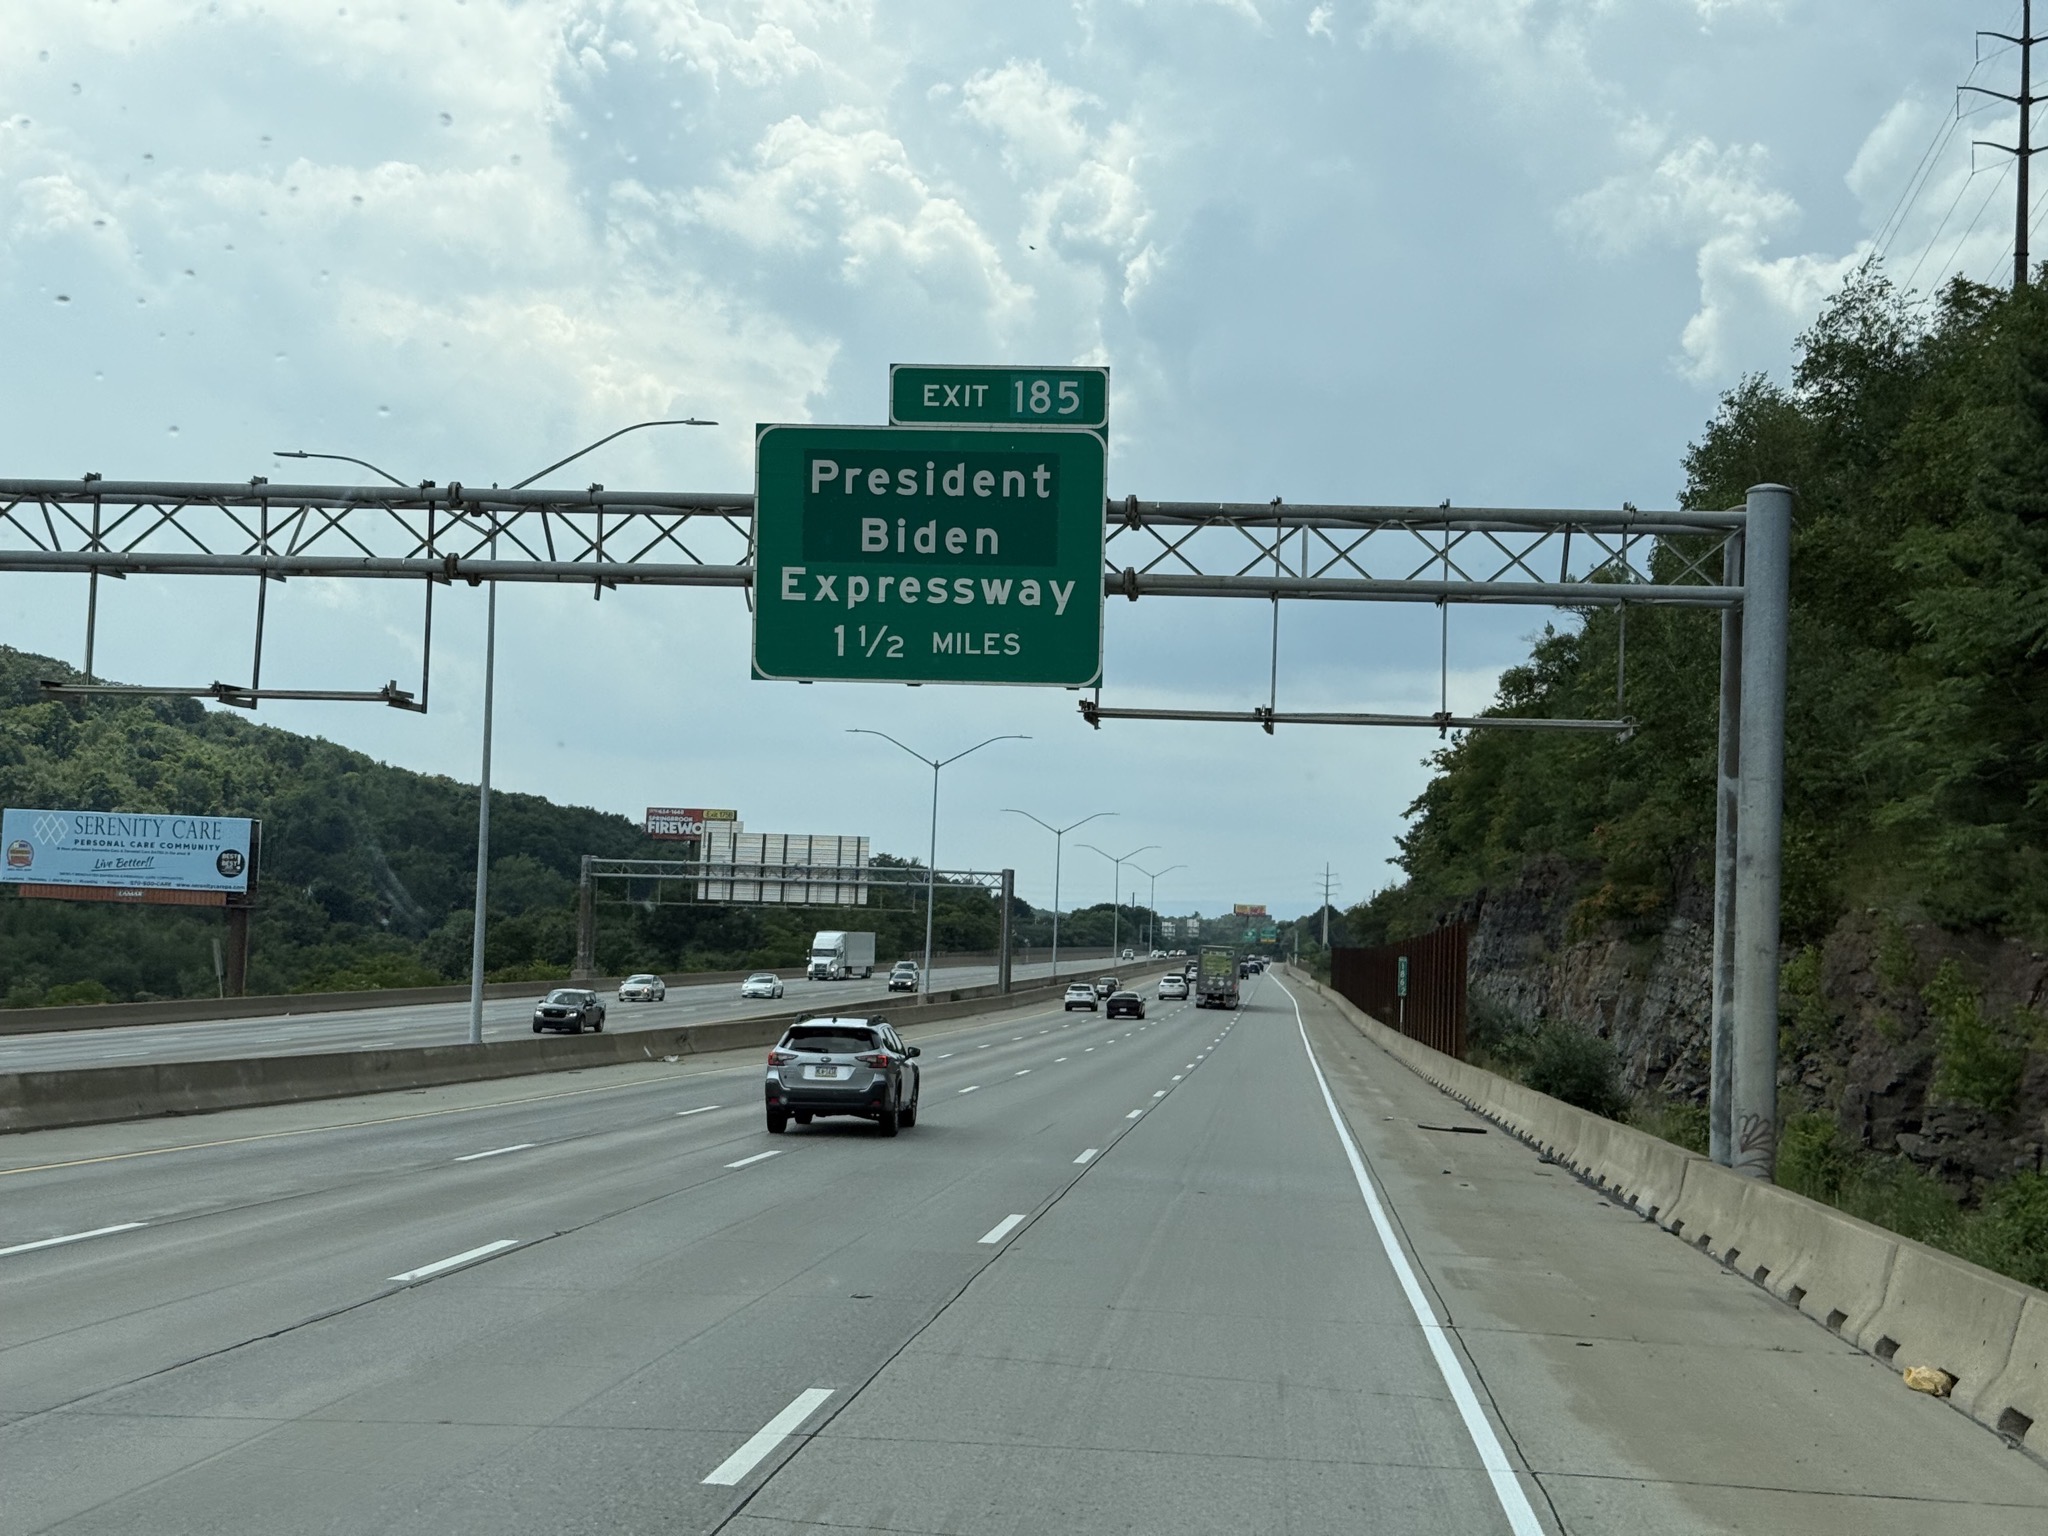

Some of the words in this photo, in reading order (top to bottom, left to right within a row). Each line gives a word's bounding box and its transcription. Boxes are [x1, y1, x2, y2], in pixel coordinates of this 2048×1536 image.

[923, 384, 989, 407] EXIT
[1014, 380, 1080, 415] 185
[811, 459, 1051, 498] President
[861, 517, 999, 555] Biden
[781, 566, 1076, 616] Expressway
[932, 632, 1020, 656] MILES
[74, 815, 166, 838] SERENITY
[172, 819, 222, 840] CARE
[74, 838, 125, 848] PERSONAL
[130, 840, 155, 849] CARE
[159, 842, 221, 851] COMMUNITY
[94, 857, 113, 869] Live
